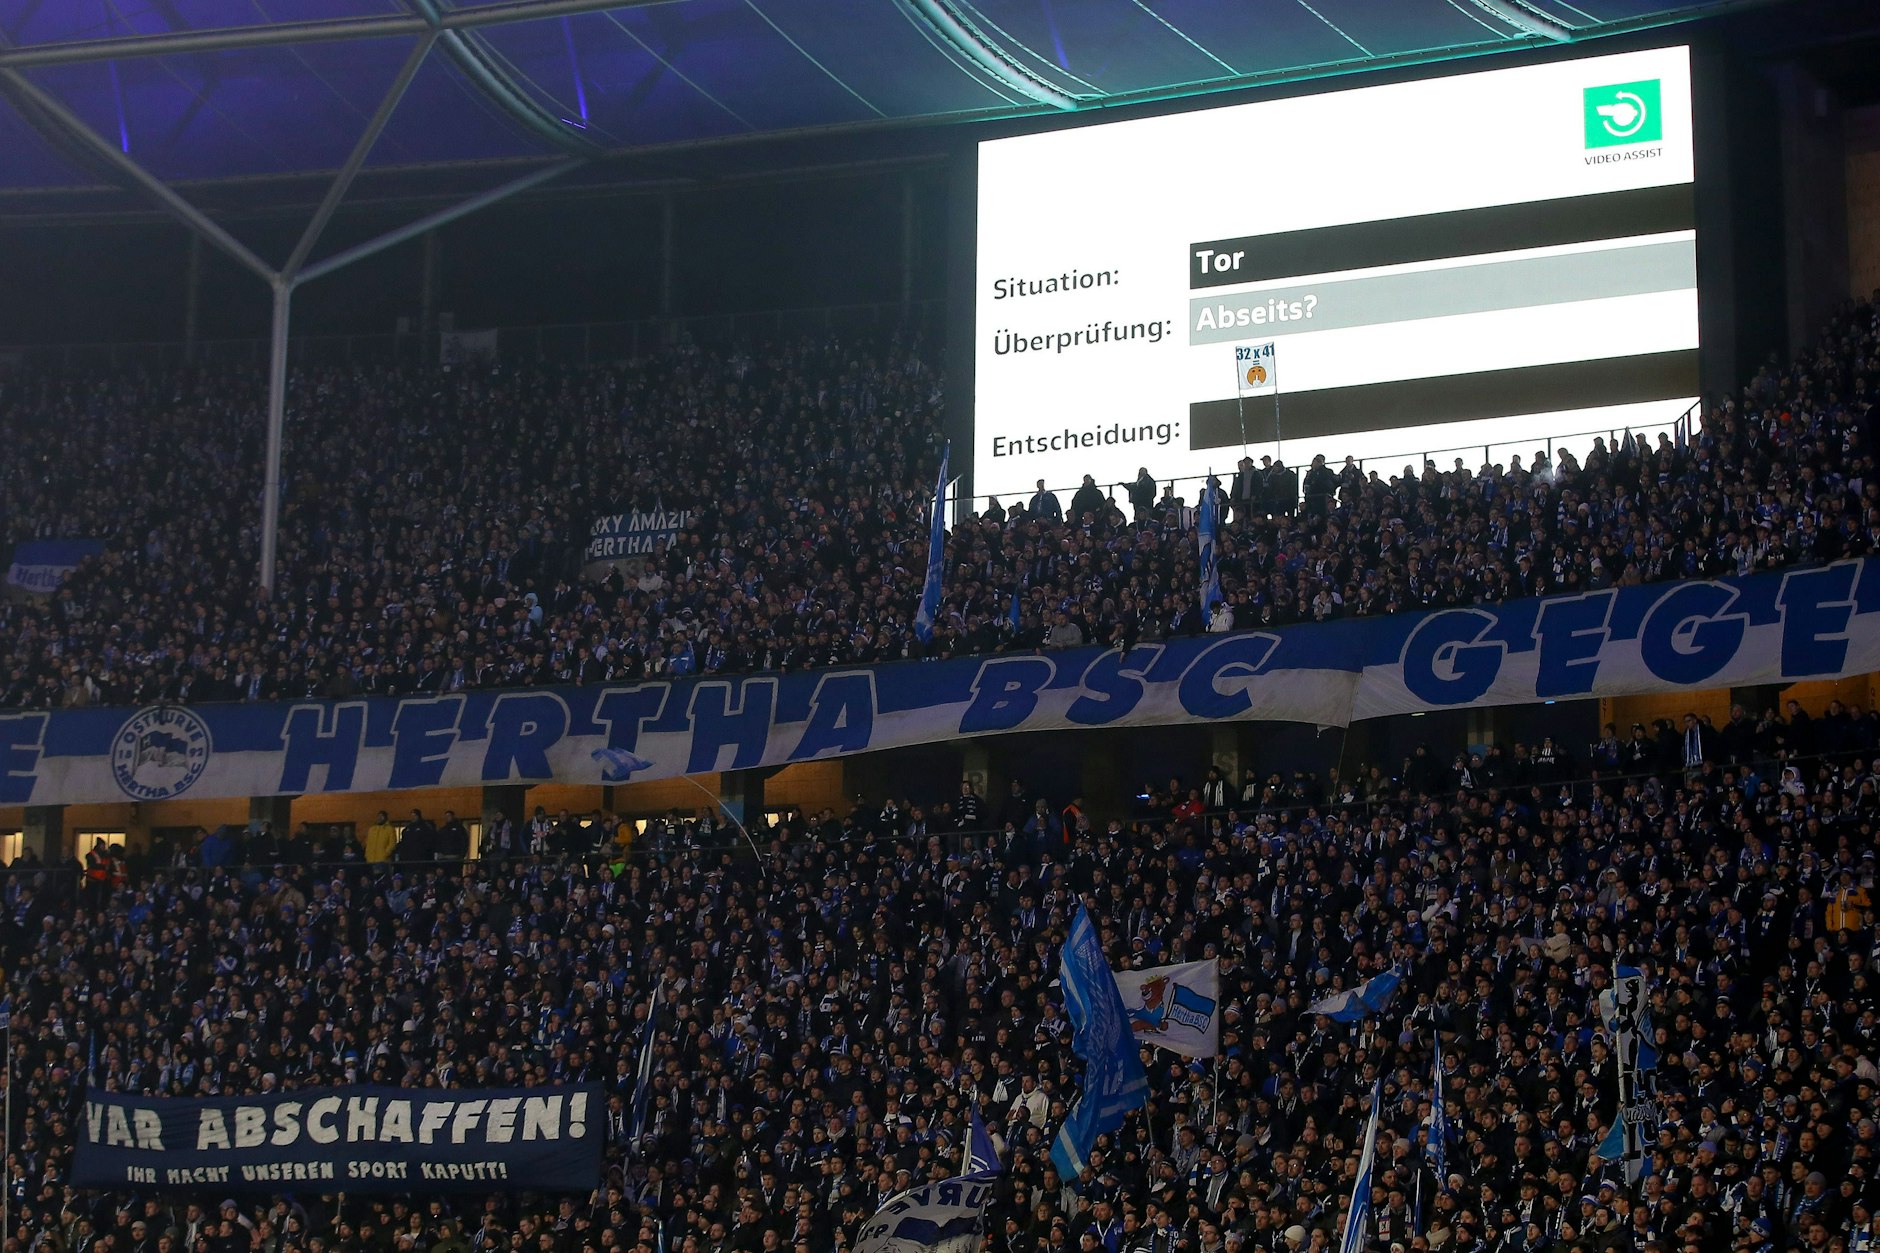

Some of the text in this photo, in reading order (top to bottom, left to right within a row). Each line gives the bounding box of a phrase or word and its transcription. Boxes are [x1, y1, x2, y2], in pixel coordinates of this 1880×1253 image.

[1584, 148, 1663, 166] VIDEO ASSIST
[994, 250, 1245, 300] Situation: Tor
[994, 294, 1318, 356] Überprüfung: Abseits?
[1237, 347, 1251, 360] 32
[1262, 343, 1275, 357] 41
[993, 422, 1180, 457] Entscheidung:
[278, 669, 878, 792] HERTHA
[959, 631, 1283, 734] BSC
[1399, 557, 1865, 705] GEGE
[117, 762, 202, 798] HERTHA BSC
[86, 1091, 588, 1151] VAR ABSCHAFFEN!
[126, 1160, 508, 1185] IHR MACHT UNSEREN SPORT KAPUTT!
